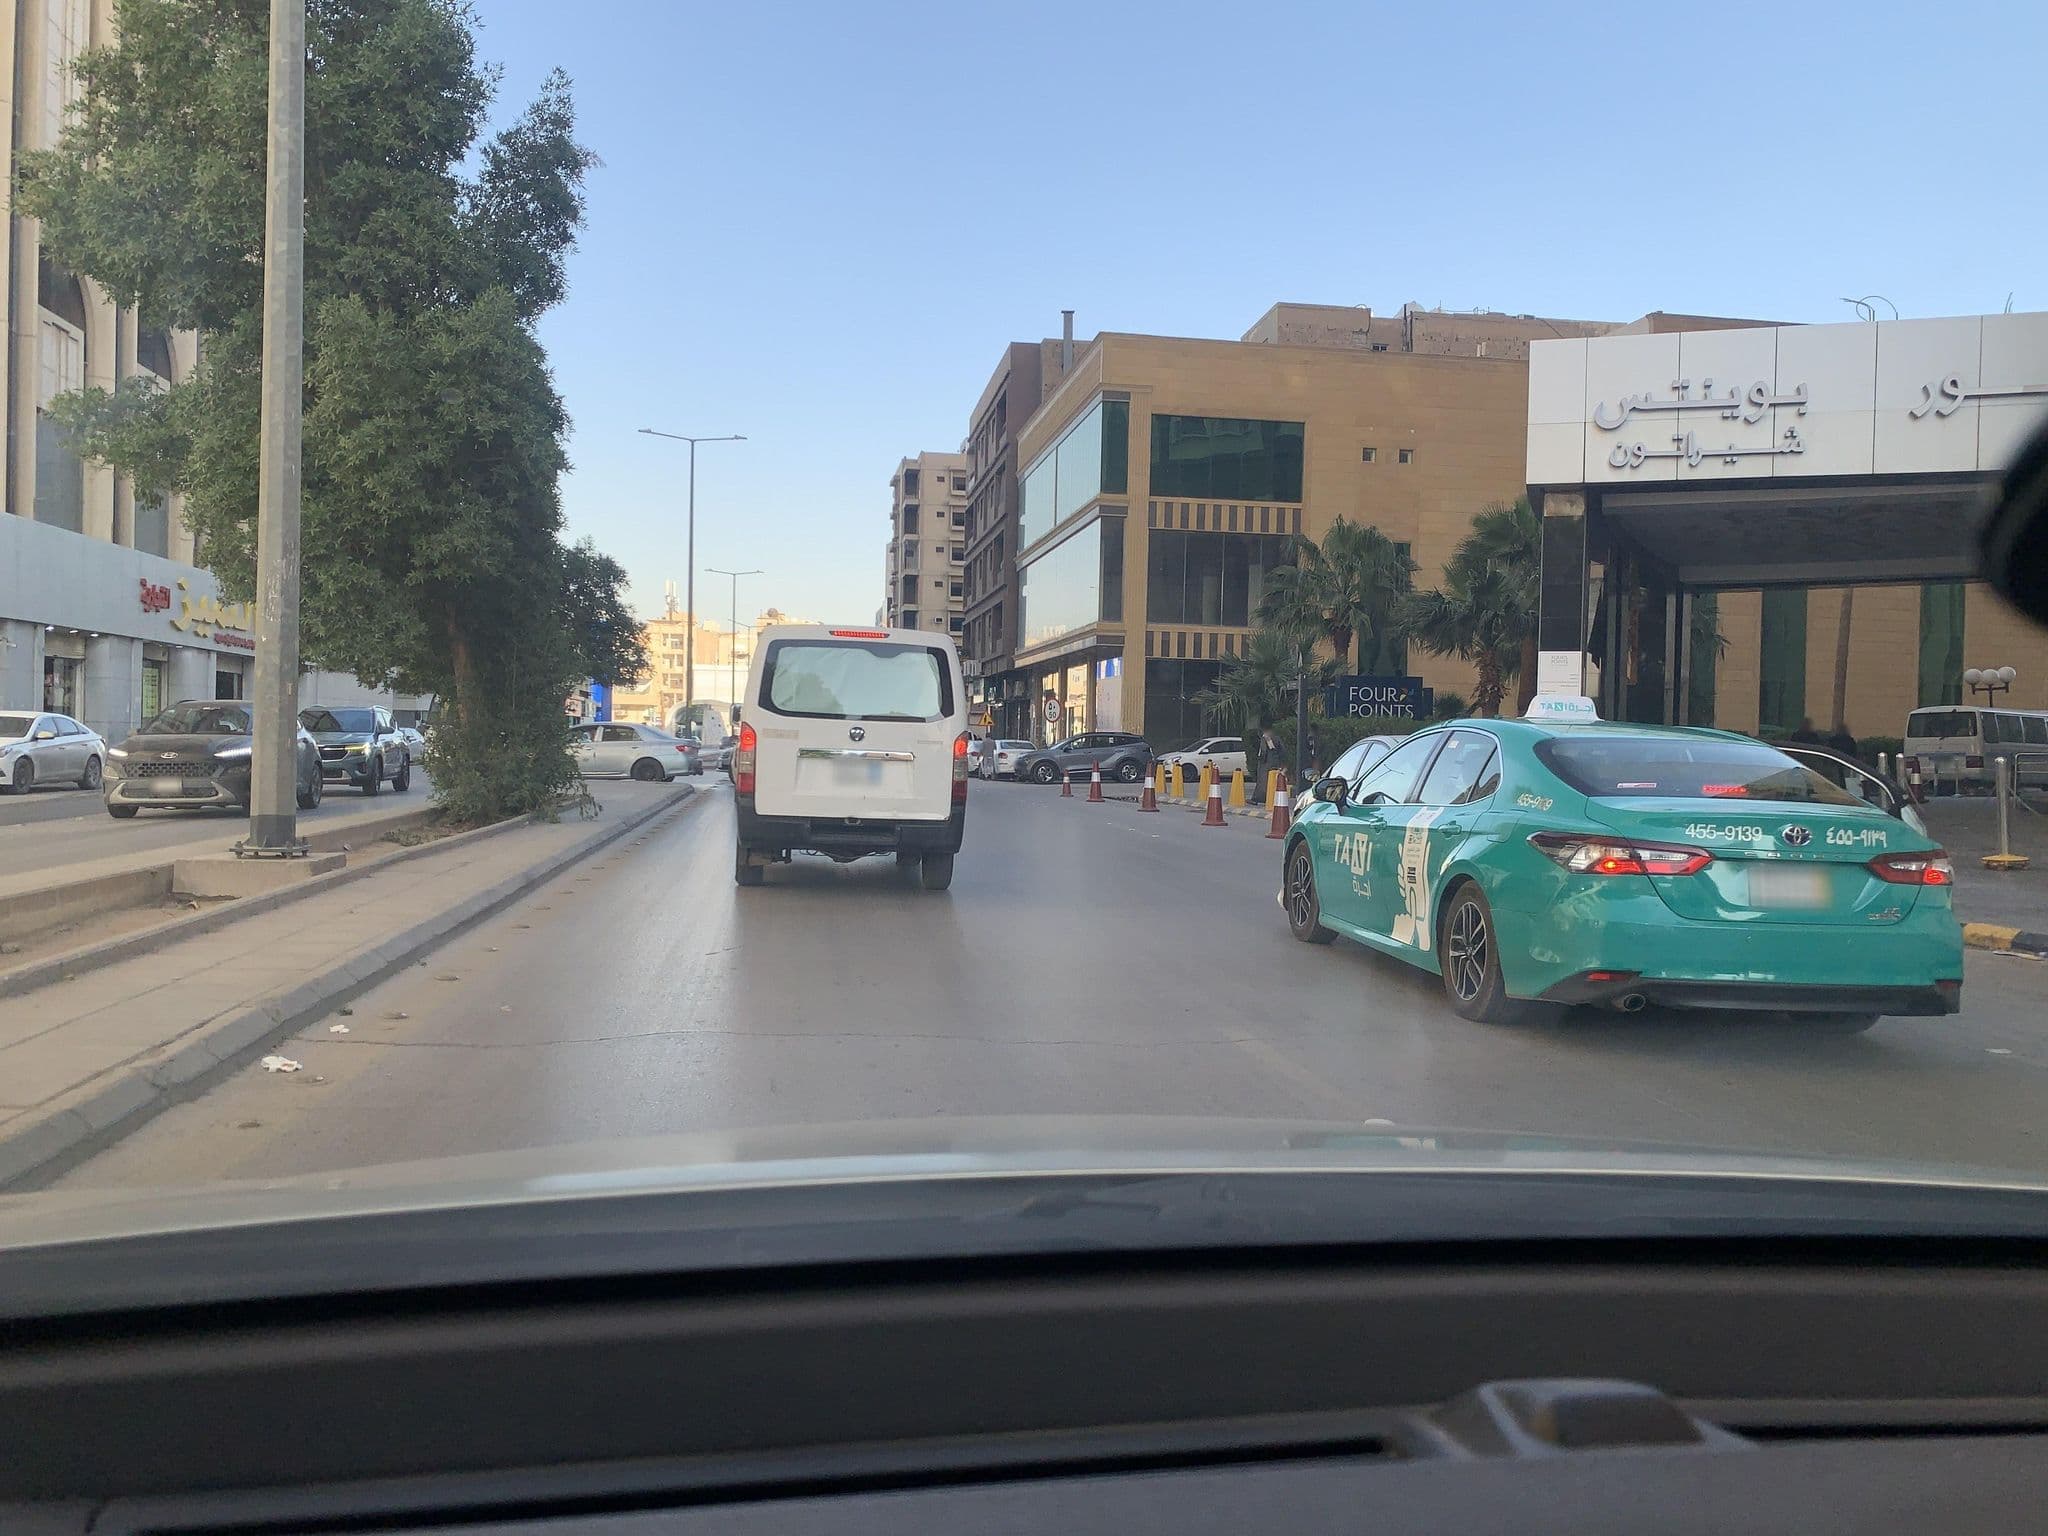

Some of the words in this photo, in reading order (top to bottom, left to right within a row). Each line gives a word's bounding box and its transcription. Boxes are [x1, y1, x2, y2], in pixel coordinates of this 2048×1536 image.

[1594, 377, 1808, 430] بوينتس
[1609, 425, 1806, 468] شيراتون
[1349, 686, 1399, 702] FOUR
[1349, 703, 1414, 719] POINTS
[1540, 702, 1568, 712] TAXI
[1685, 823, 1763, 842] 455-9139
[1334, 832, 1373, 877] TAXI
